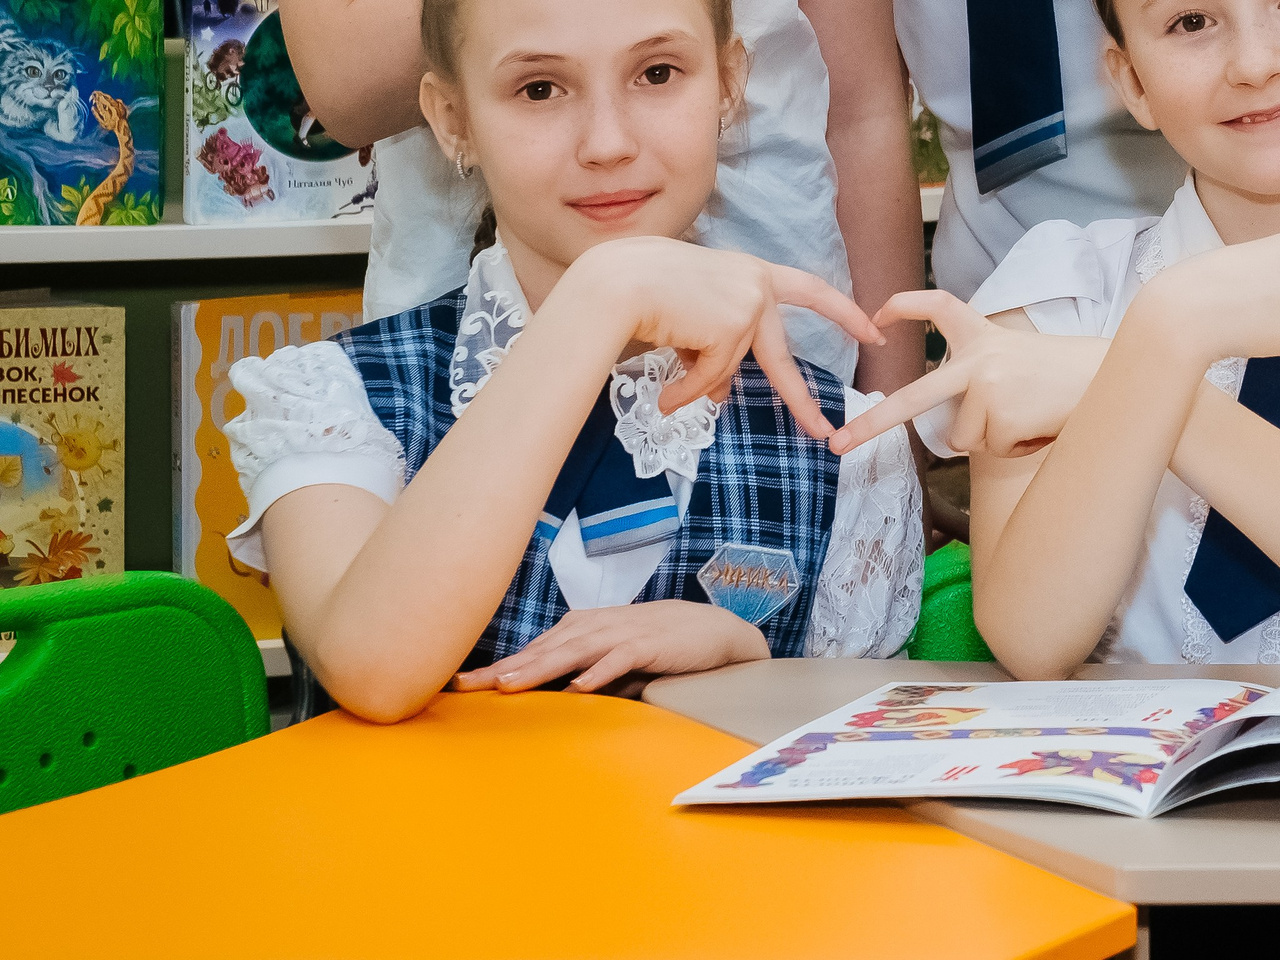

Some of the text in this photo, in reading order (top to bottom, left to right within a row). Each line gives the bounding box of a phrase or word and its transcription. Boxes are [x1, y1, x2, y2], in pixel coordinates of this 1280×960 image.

[288, 177, 354, 189] Наталия Чуб
[0, 326, 100, 359] БИМЫХ
[211, 311, 363, 380] ДОБР
[2, 386, 100, 404] ПЕСЕНОК
